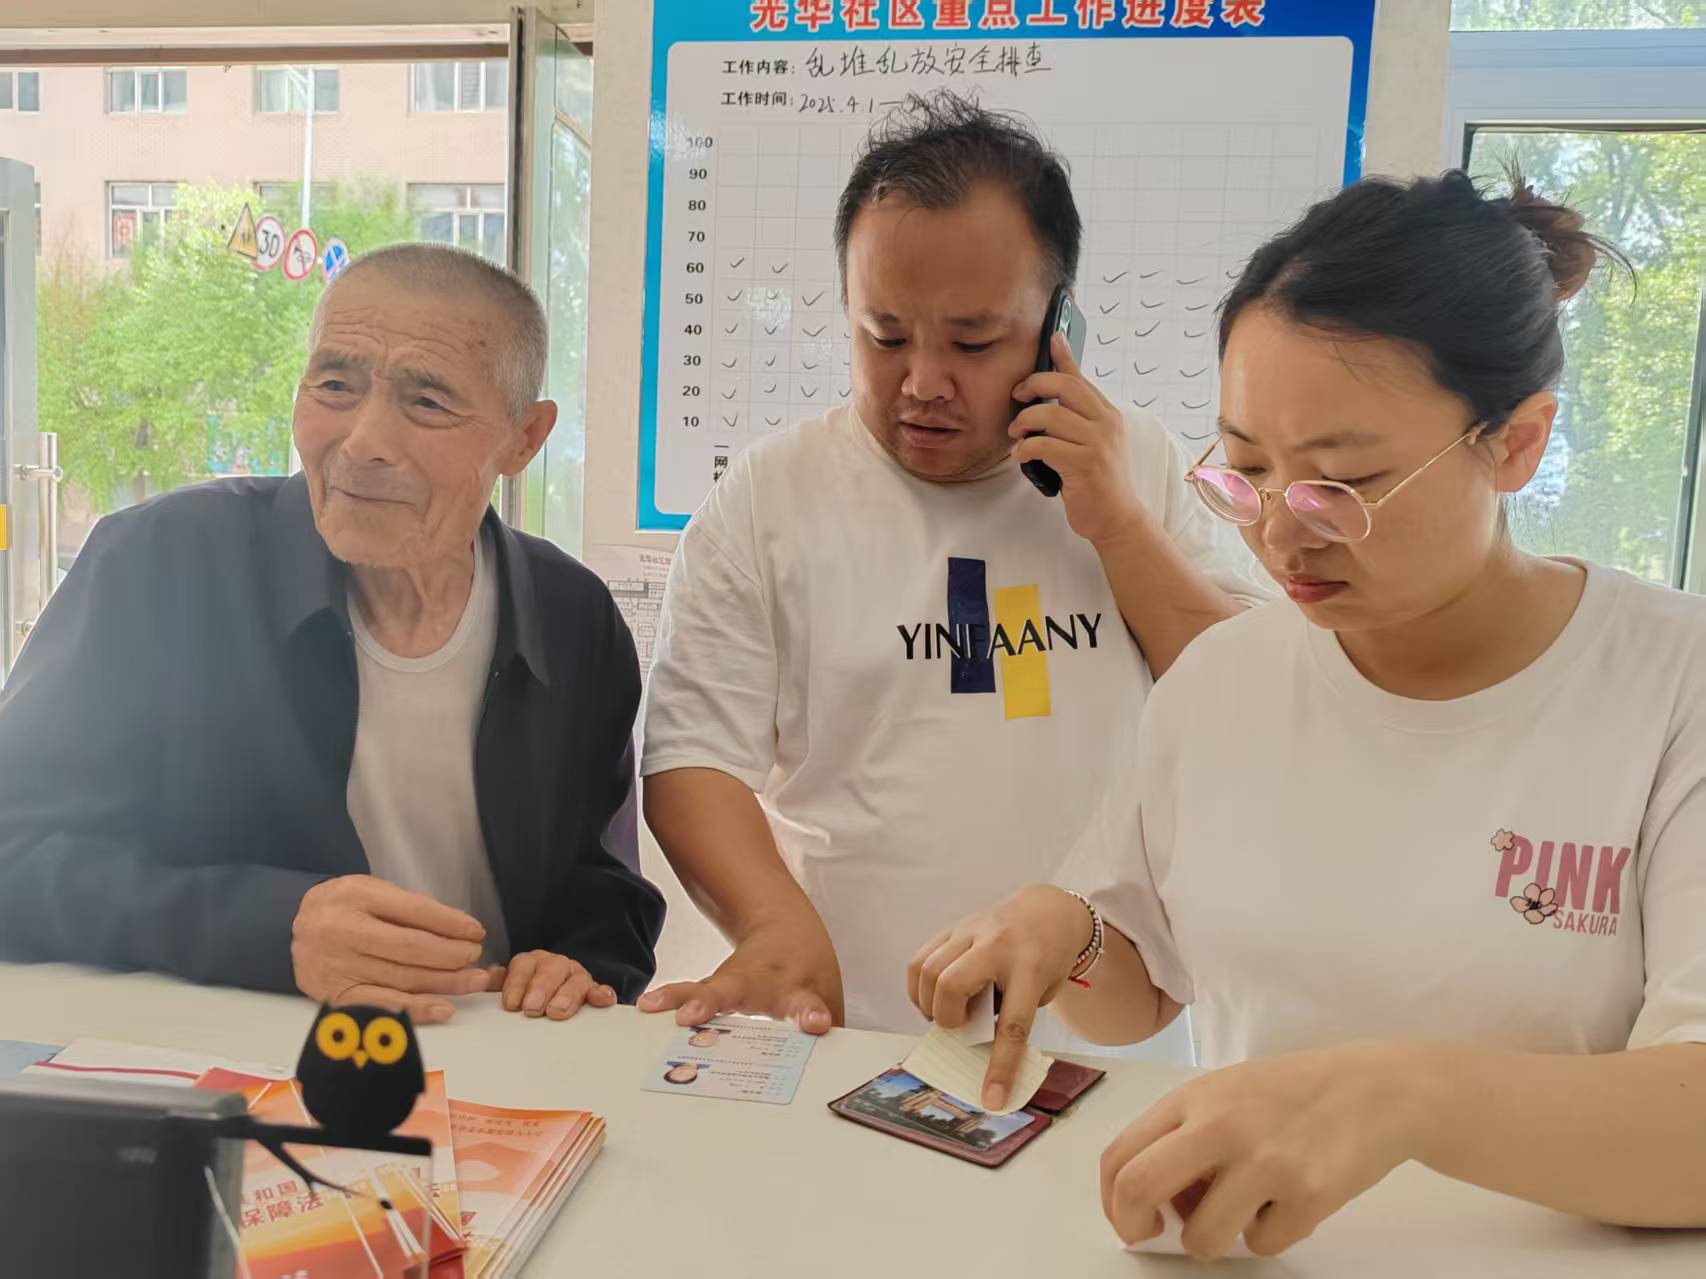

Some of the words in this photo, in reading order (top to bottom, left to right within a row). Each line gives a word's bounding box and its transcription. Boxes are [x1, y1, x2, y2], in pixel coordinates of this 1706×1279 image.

[751, 0, 1264, 30] 光华社区重点工作进度表
[689, 168, 707, 180] 90
[688, 200, 706, 211] 80
[688, 231, 705, 242] 70
[259, 229, 280, 258] 30
[686, 262, 704, 273] 60
[685, 293, 703, 304] 50
[684, 324, 702, 335] 40
[683, 355, 701, 366] 30
[682, 386, 700, 397] 20
[683, 416, 699, 427] 10
[1495, 835, 1631, 914] PINK
[1553, 910, 1617, 936] SAKURA
[241, 1180, 298, 1204] 和国
